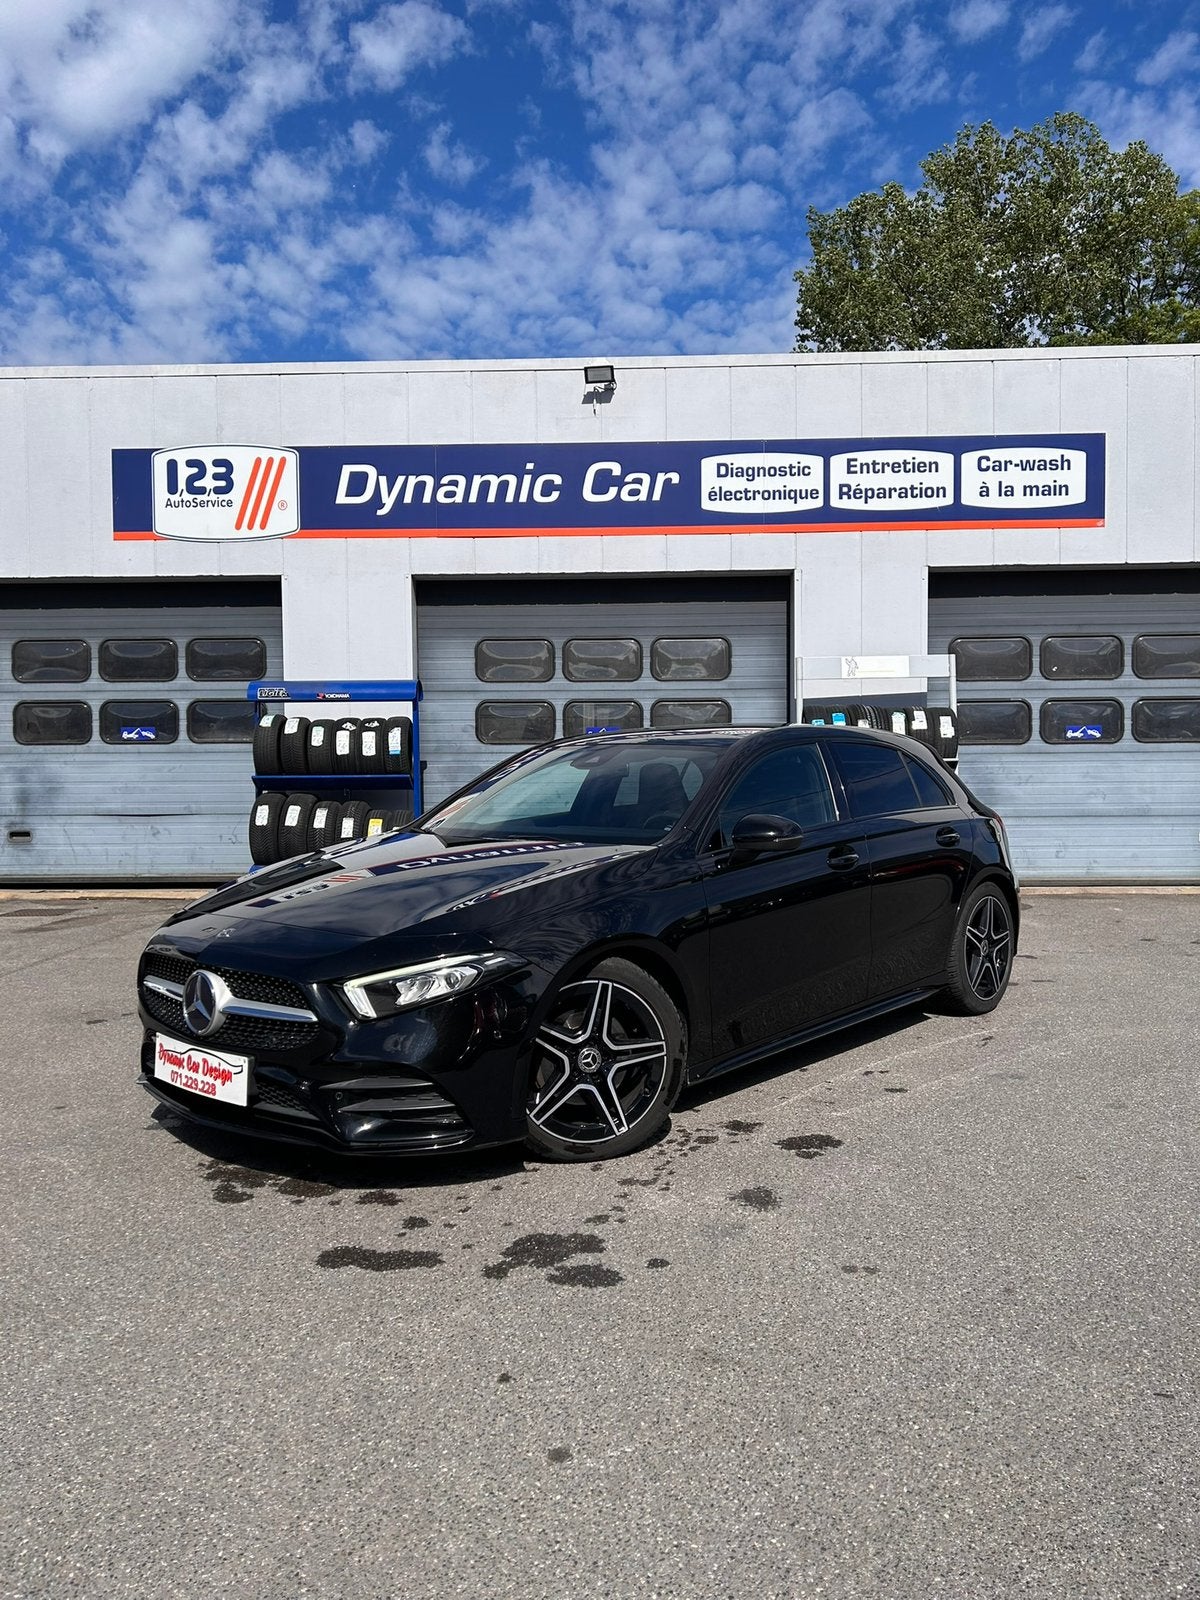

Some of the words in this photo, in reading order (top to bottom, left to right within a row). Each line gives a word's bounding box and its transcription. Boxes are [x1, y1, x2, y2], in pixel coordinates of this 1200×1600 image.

[716, 461, 812, 480] Diagnostic
[846, 457, 939, 475] Entretien
[977, 453, 1071, 473] Car-wash
[336, 463, 562, 516] Dynamic
[583, 461, 680, 502] Car
[708, 483, 820, 505] électronique
[838, 482, 947, 503] Réparation
[979, 479, 990, 498] à
[998, 479, 1015, 497] la
[1022, 477, 1069, 497] main
[165, 497, 233, 508] AutoService
[186, 1054, 200, 1074] Car
[202, 1057, 233, 1087] Design
